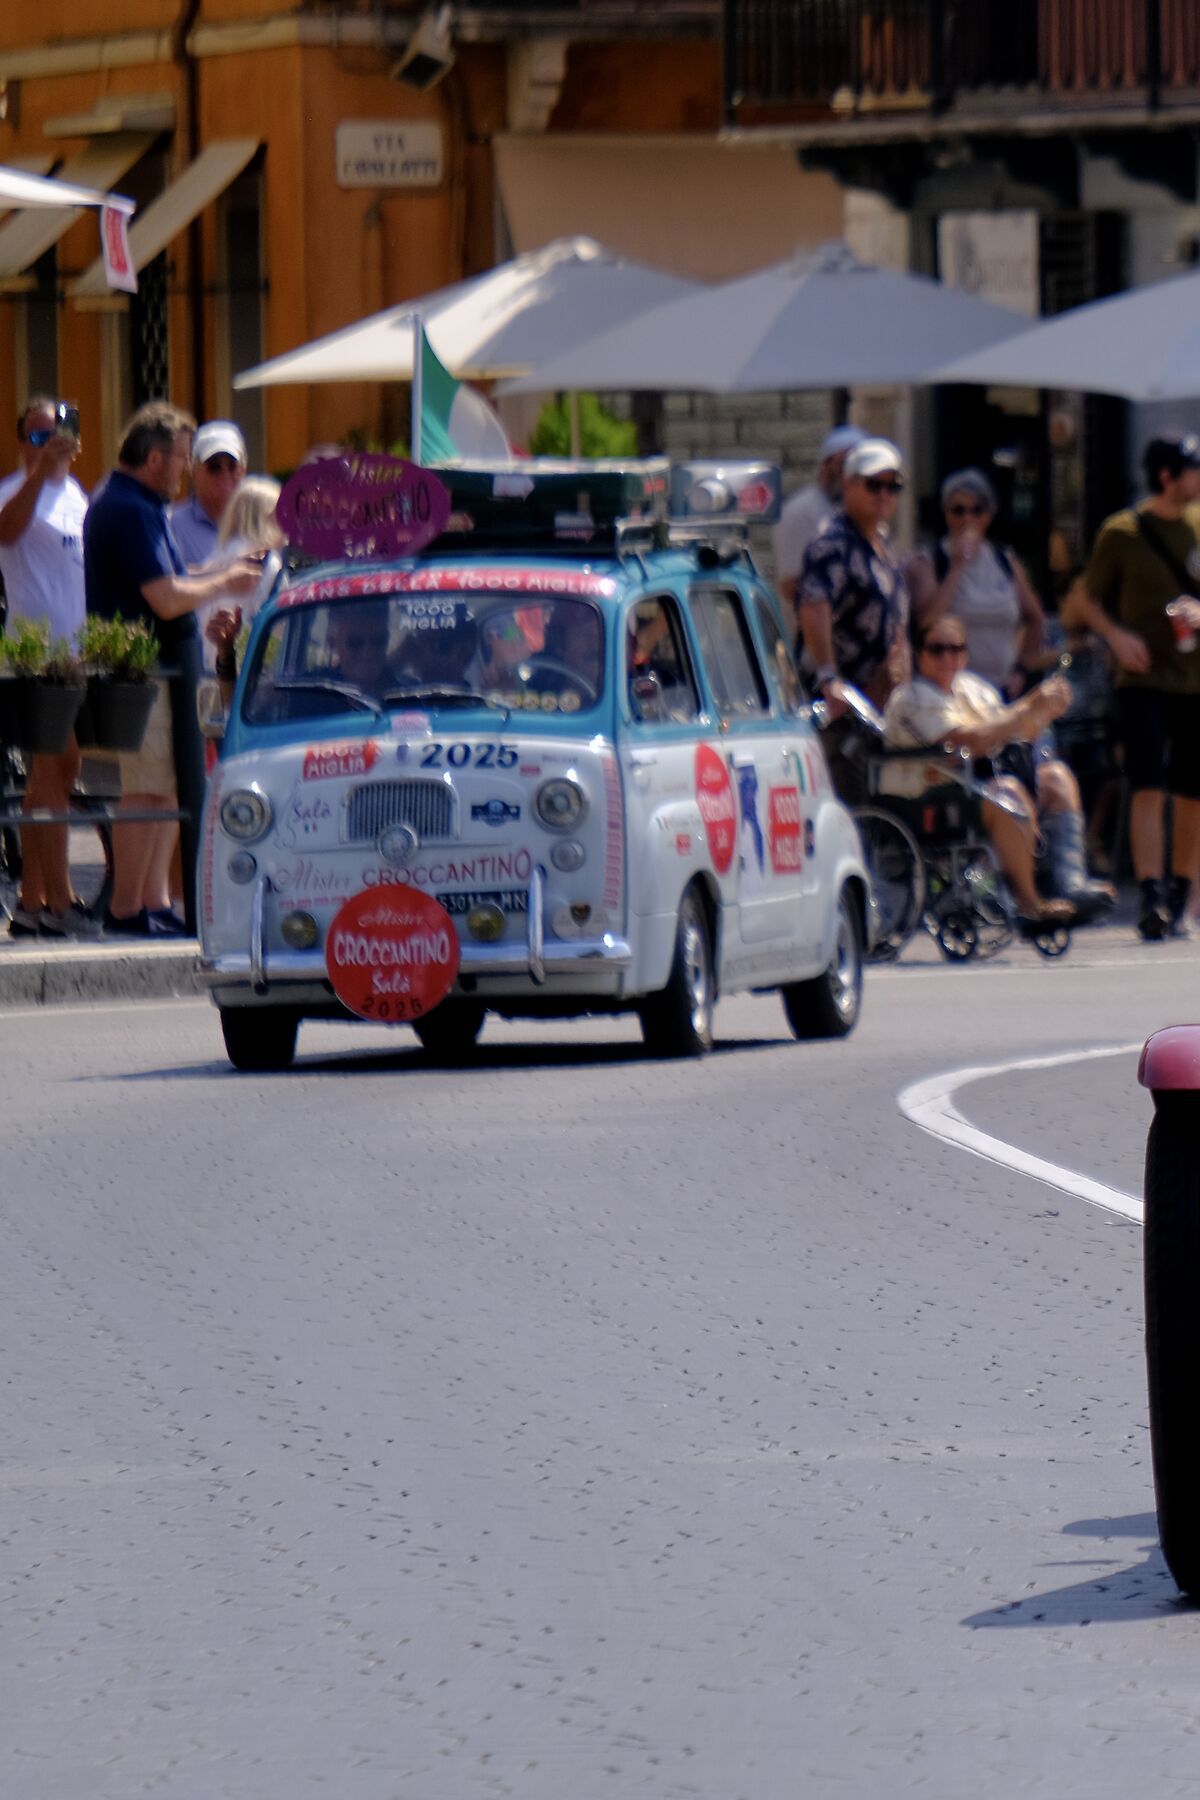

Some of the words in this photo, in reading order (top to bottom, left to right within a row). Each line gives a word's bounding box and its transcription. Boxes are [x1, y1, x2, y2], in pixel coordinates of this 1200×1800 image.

[362, 574, 439, 593] DELLA
[459, 576, 520, 589] 1000
[406, 603, 455, 616] 1000
[420, 743, 519, 768] 2025
[307, 757, 366, 778] MIGLIA
[362, 848, 532, 887] CROCCANTINO
[333, 929, 450, 967] CROCCANTINO
[372, 970, 410, 995] Salò
[361, 996, 423, 1018] 2025
